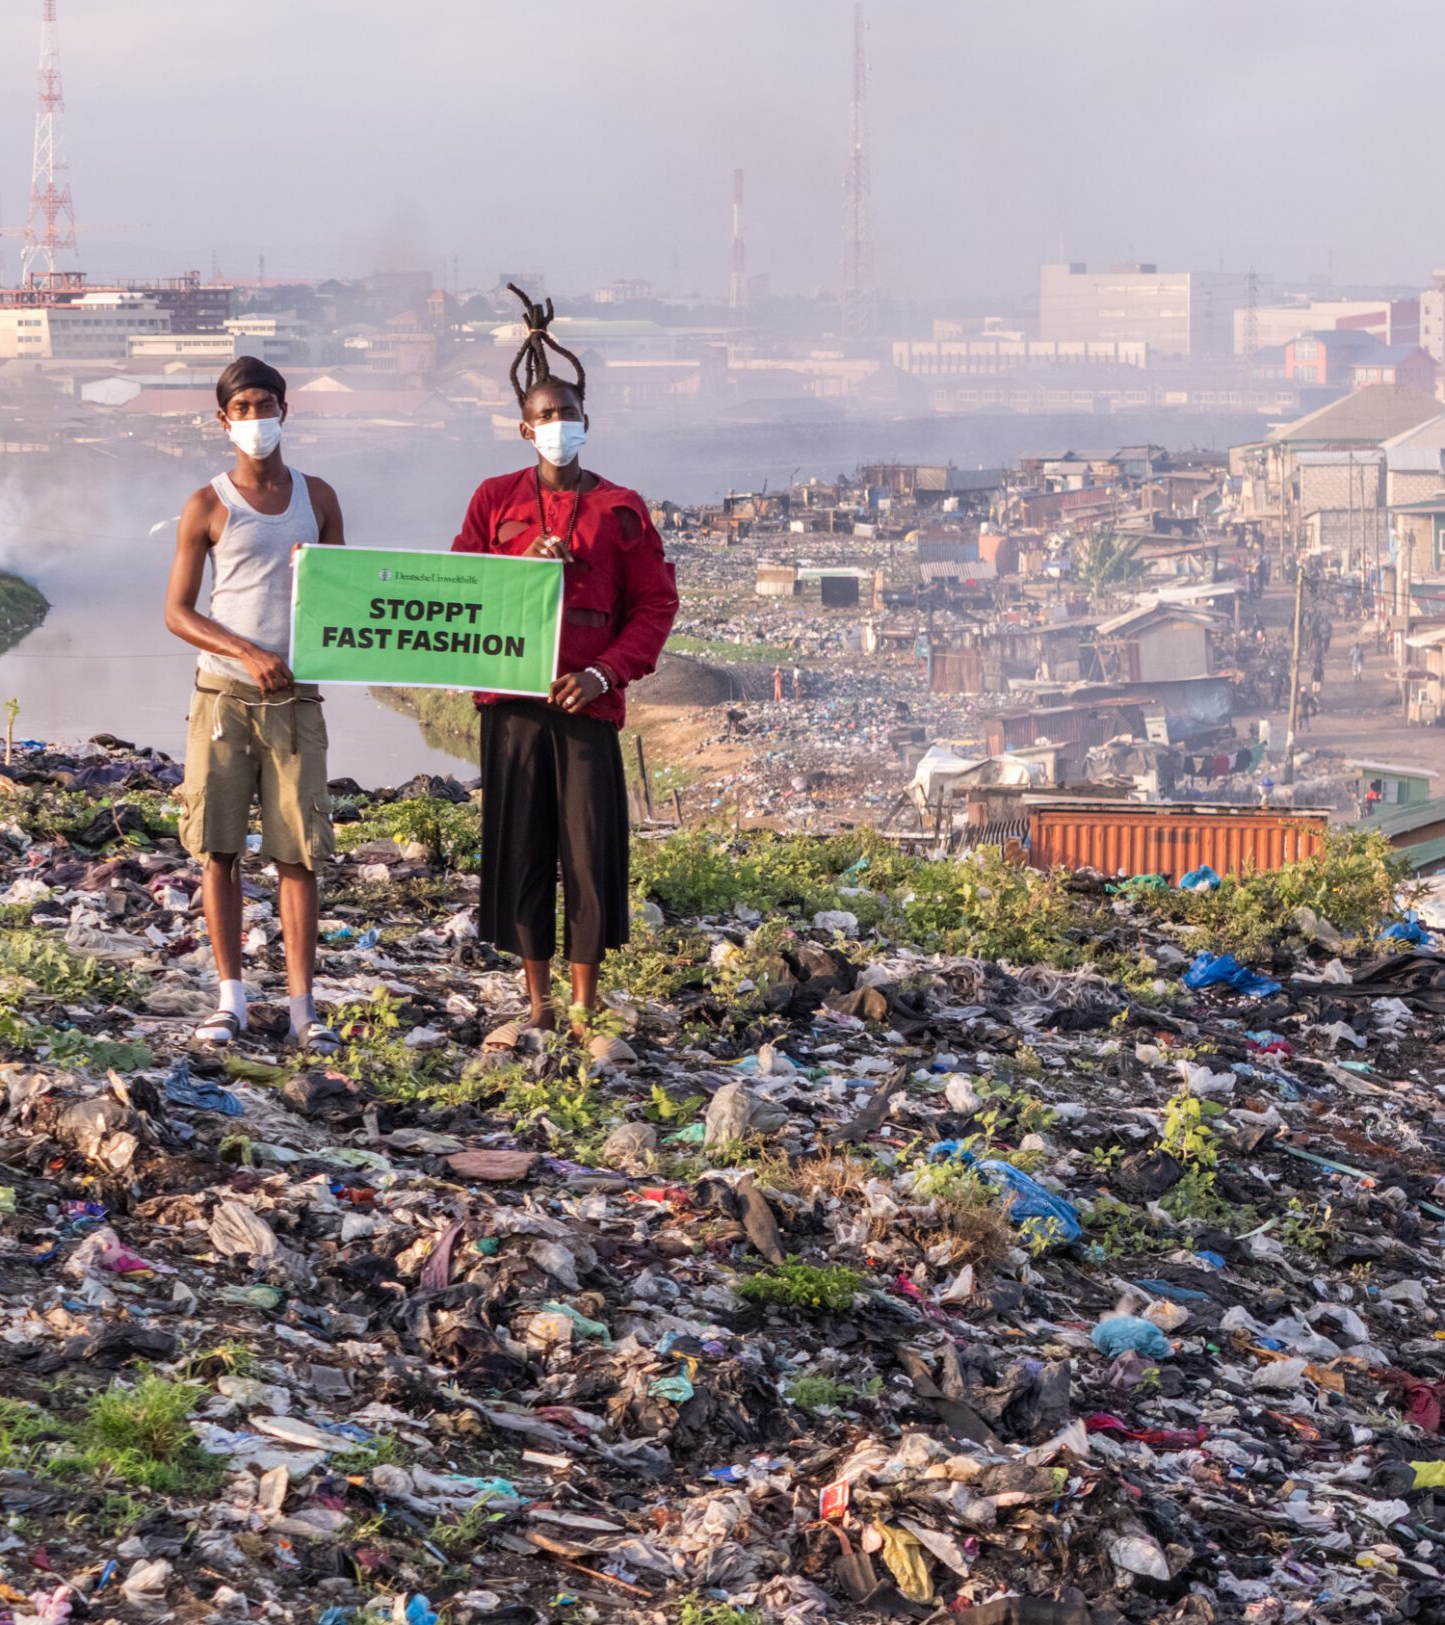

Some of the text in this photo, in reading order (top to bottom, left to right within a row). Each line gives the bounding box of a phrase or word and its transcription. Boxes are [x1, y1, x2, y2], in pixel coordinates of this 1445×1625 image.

[370, 597, 483, 624] STOPPT
[322, 626, 525, 658] FAST FASHION
